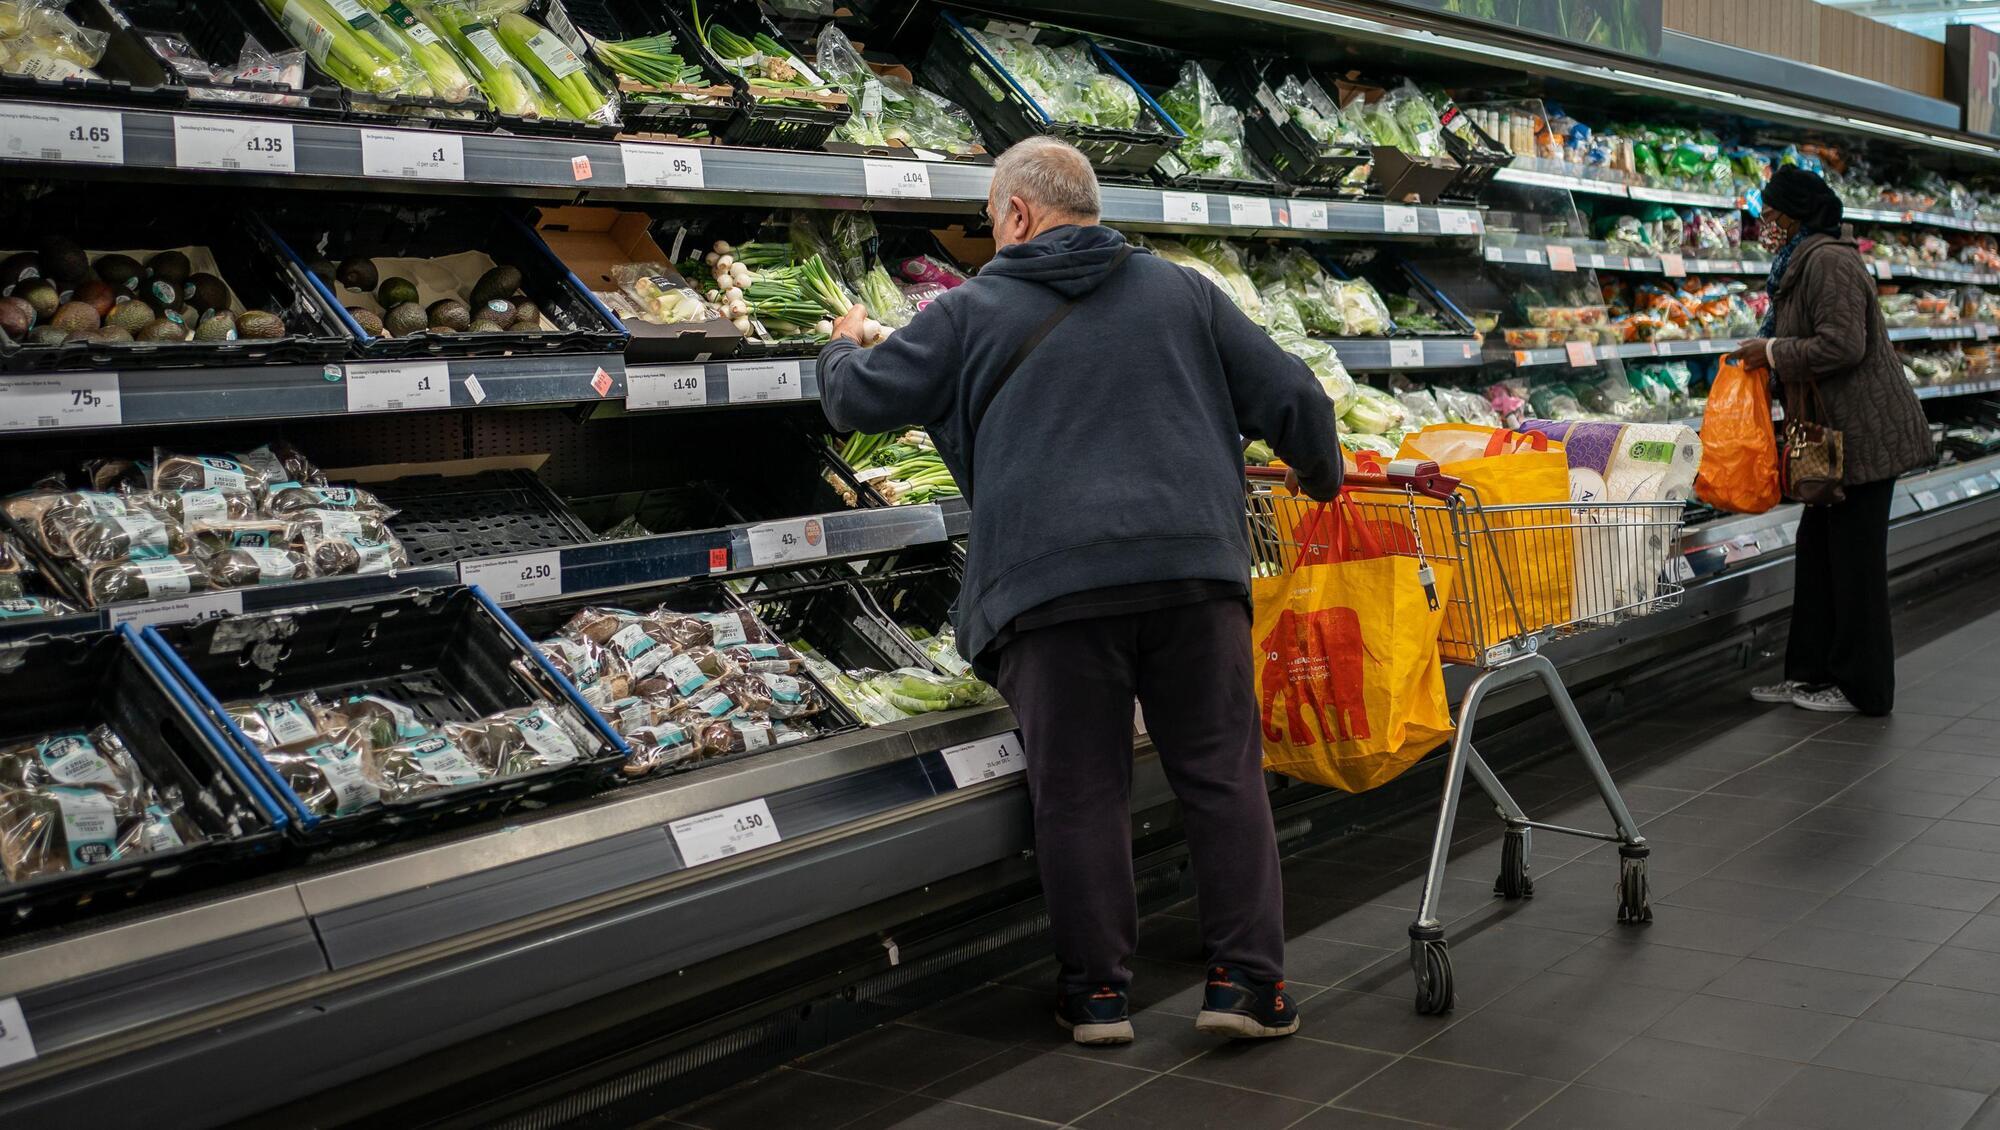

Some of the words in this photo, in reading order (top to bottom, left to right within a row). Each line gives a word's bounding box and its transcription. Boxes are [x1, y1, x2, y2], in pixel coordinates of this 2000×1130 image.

[69, 125, 110, 143] £1.65
[247, 136, 283, 152] £1.35
[432, 147, 445, 161] £1
[673, 159, 692, 174] 95p
[903, 172, 923, 183] £1.04
[417, 376, 431, 391] £1
[673, 377, 698, 390] £1.40
[777, 372, 788, 385] £1
[71, 389, 101, 408] 75p
[781, 532, 798, 546] 43p
[521, 564, 551, 580] £2.50
[998, 744, 1009, 758] £1
[734, 813, 763, 833] £1.50
[1274, 996, 1285, 1011] S
